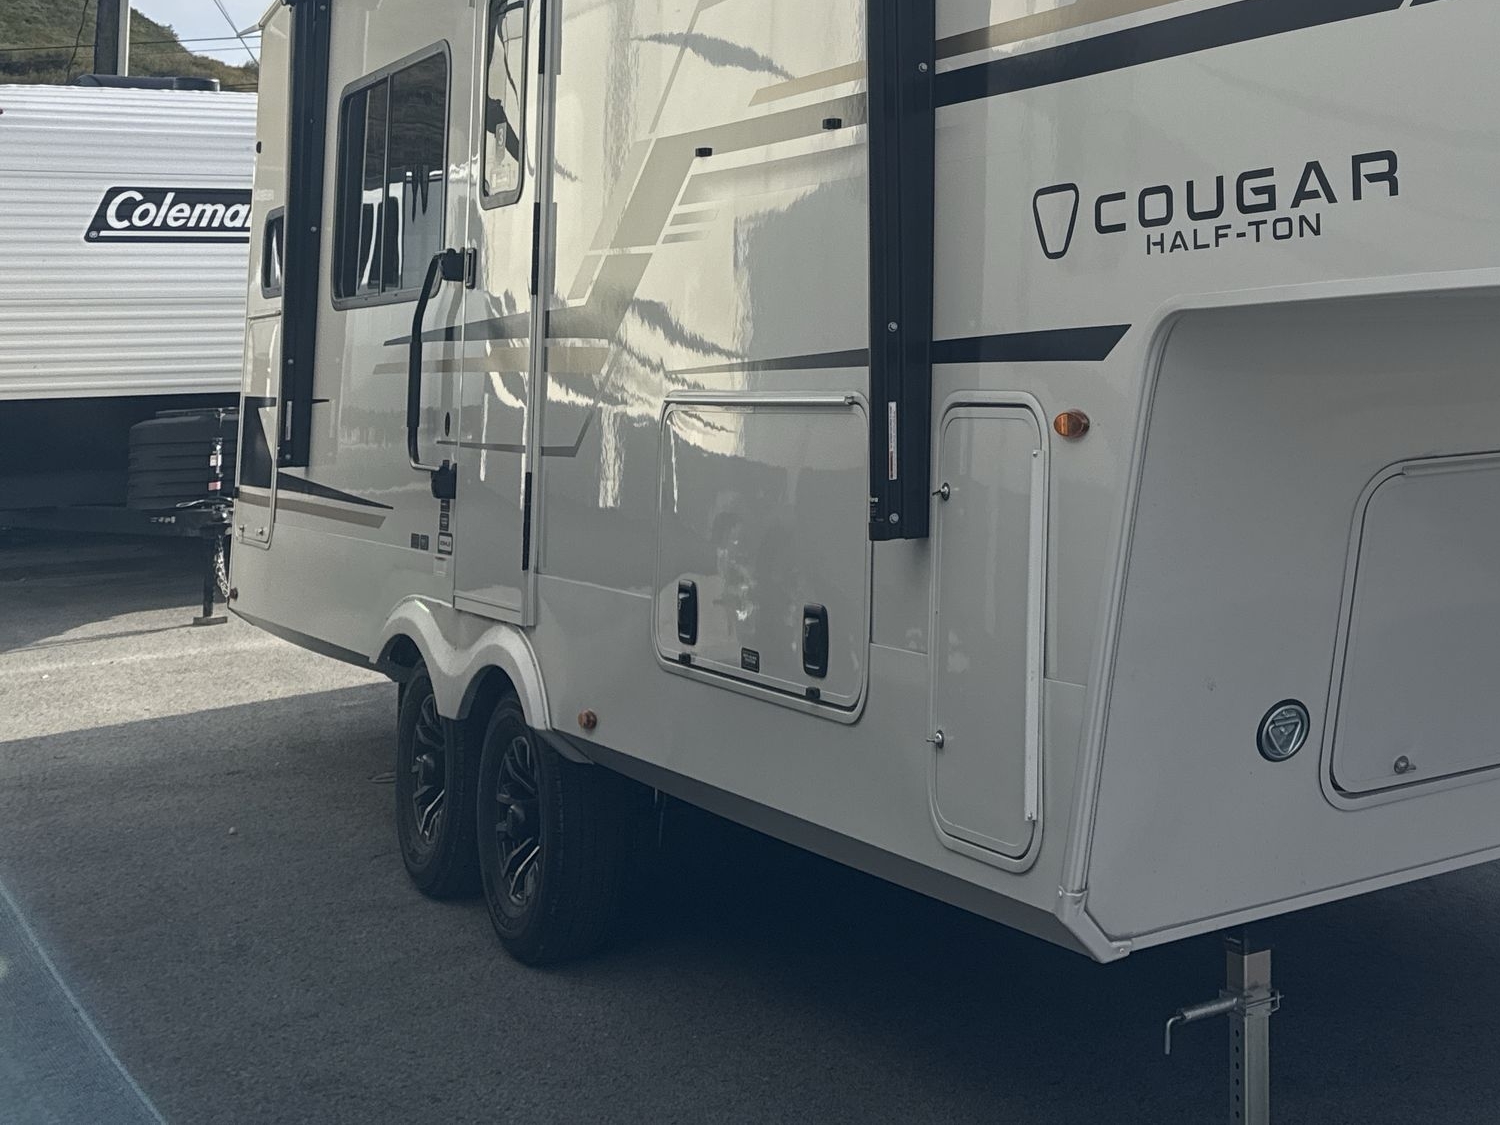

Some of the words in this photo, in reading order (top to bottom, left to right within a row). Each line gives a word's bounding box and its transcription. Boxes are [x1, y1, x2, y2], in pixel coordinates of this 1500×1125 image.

[106, 190, 252, 229] Colema
[1094, 149, 1399, 235] COUGAR
[1146, 213, 1321, 255] HALF-TON
